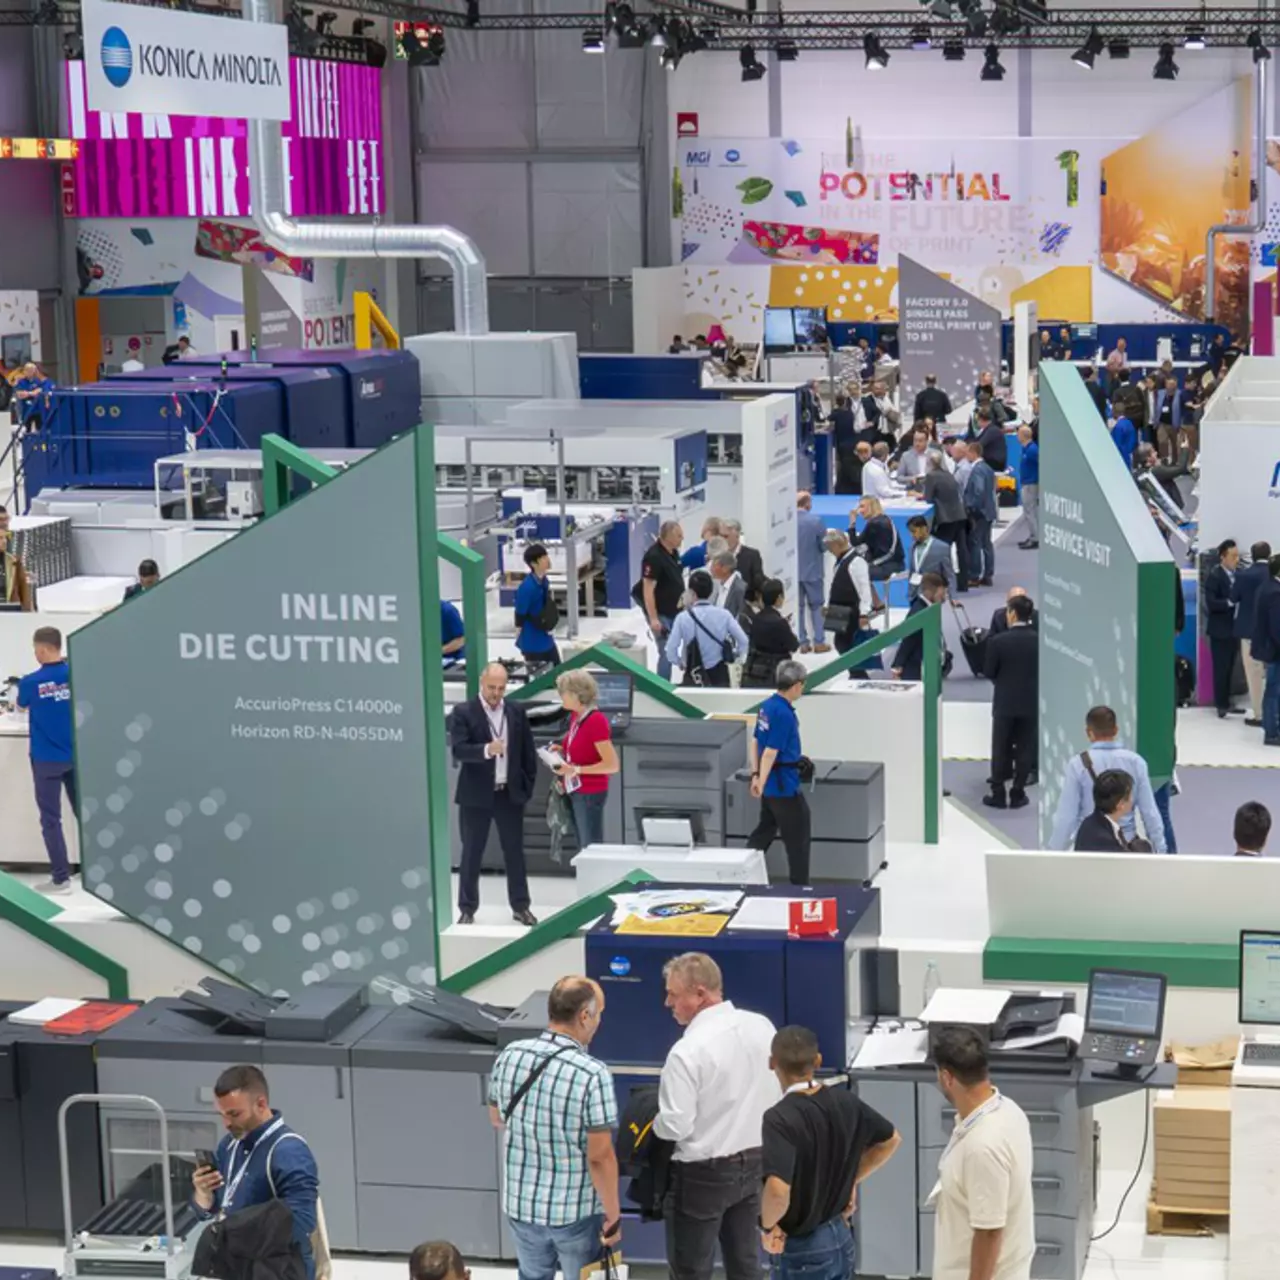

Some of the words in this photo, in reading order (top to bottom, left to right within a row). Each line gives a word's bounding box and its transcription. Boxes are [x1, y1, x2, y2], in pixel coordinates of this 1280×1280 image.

[140, 45, 208, 79] KONICA
[212, 55, 282, 87] MINOLTA
[820, 171, 1011, 201] POTENTIAL
[889, 204, 1027, 232] FUTURE
[906, 298, 950, 307] FACTORY
[906, 309, 941, 318] SINGLE
[943, 309, 969, 319] PASS
[906, 321, 945, 330] DIGITAL
[947, 321, 977, 331] PRINT
[979, 322, 993, 331] UP
[906, 332, 919, 341] TO
[1044, 491, 1084, 524] VIRTUAL
[1044, 523, 1084, 558] SERVICE
[1084, 538, 1111, 568] VISIT
[281, 593, 399, 621] INLINE
[179, 633, 237, 660] DIE
[245, 634, 400, 664] CUTTING
[234, 697, 332, 713] AccurioPress
[334, 698, 404, 714] C14000e
[231, 723, 291, 739] Horizon
[294, 725, 404, 743] RD-N-4055DM
